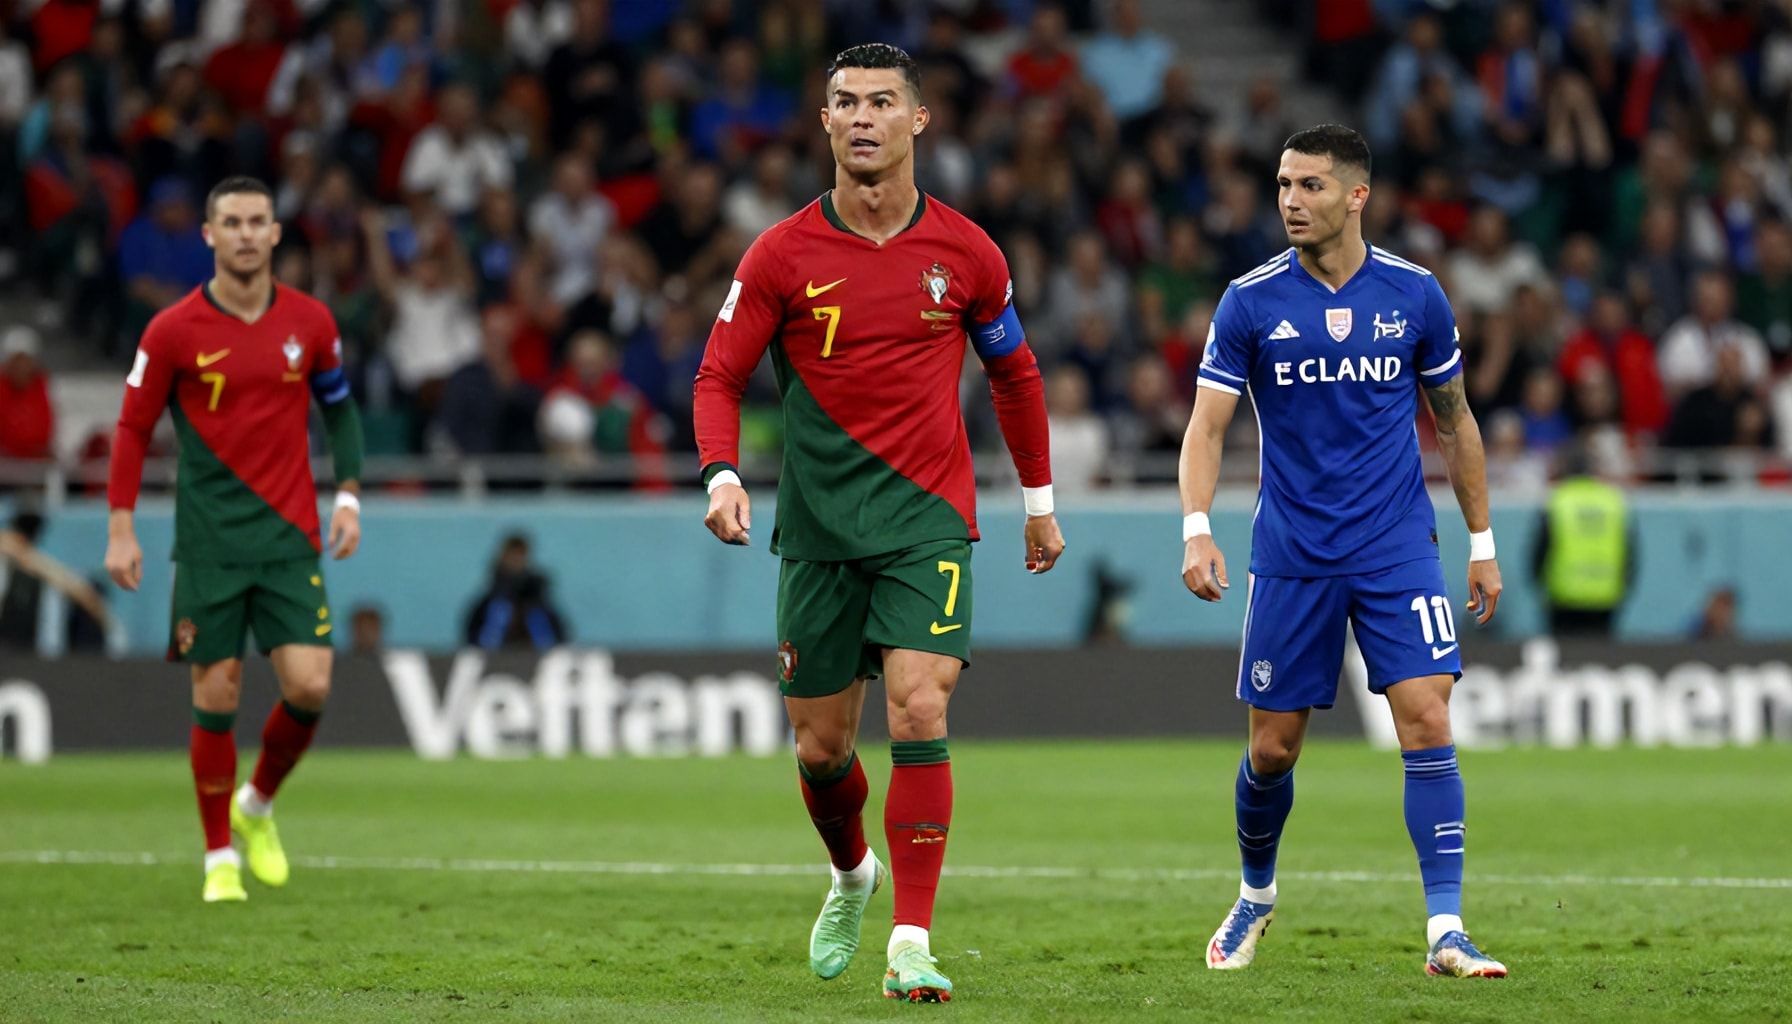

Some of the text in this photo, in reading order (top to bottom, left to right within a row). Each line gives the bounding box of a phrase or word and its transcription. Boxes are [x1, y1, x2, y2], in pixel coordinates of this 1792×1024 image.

[811, 306, 841, 358] 7
[200, 372, 226, 412] 7
[938, 560, 960, 617] 7
[1410, 595, 1456, 645] 10
